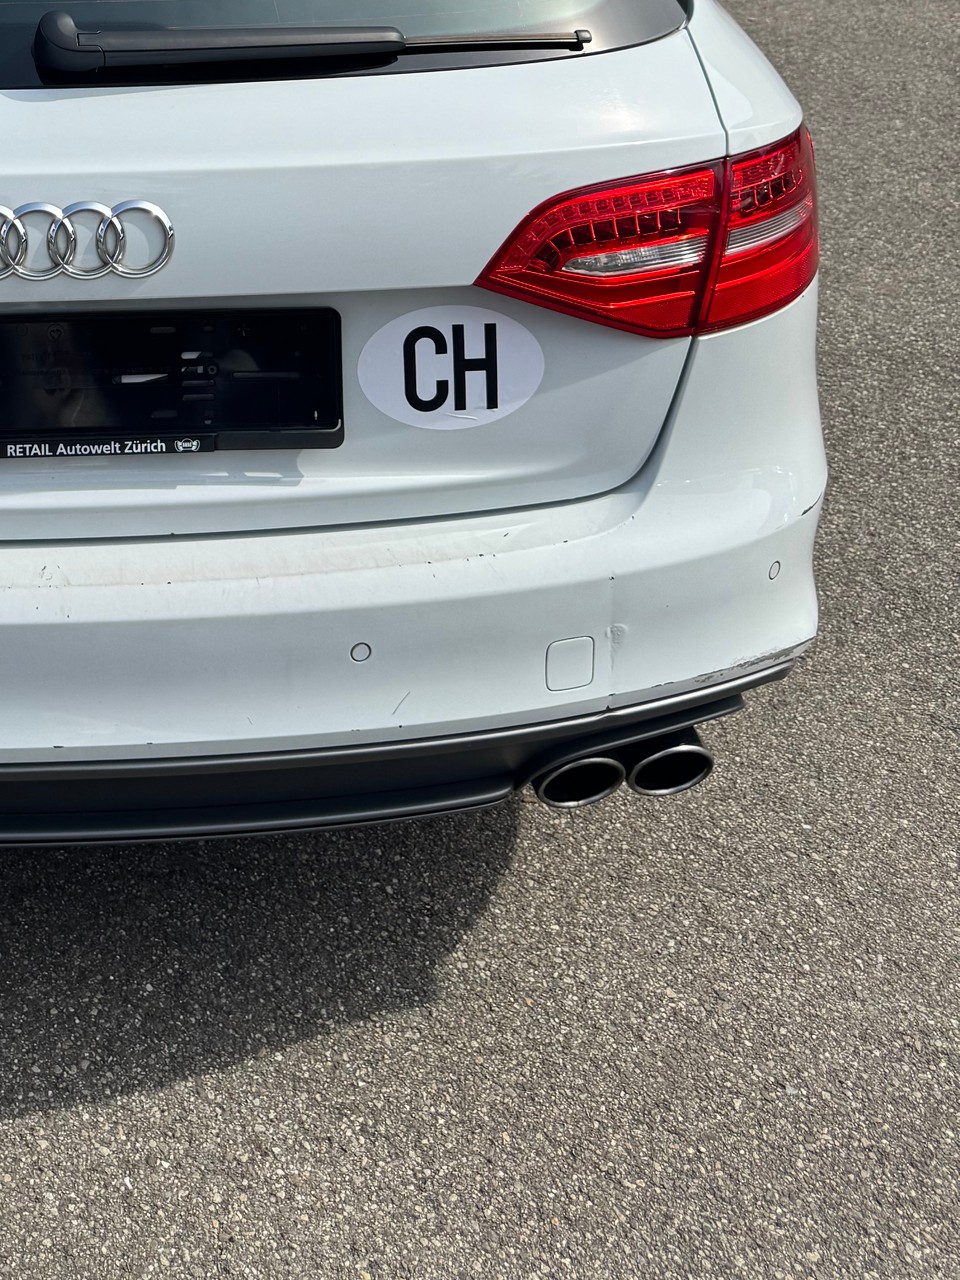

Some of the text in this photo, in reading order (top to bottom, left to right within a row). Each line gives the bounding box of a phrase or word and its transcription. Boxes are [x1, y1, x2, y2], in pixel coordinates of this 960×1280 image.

[403, 323, 499, 412] CH
[6, 444, 53, 457] RETAIL
[55, 441, 122, 456] Autowelt
[124, 439, 166, 454] Zürich
